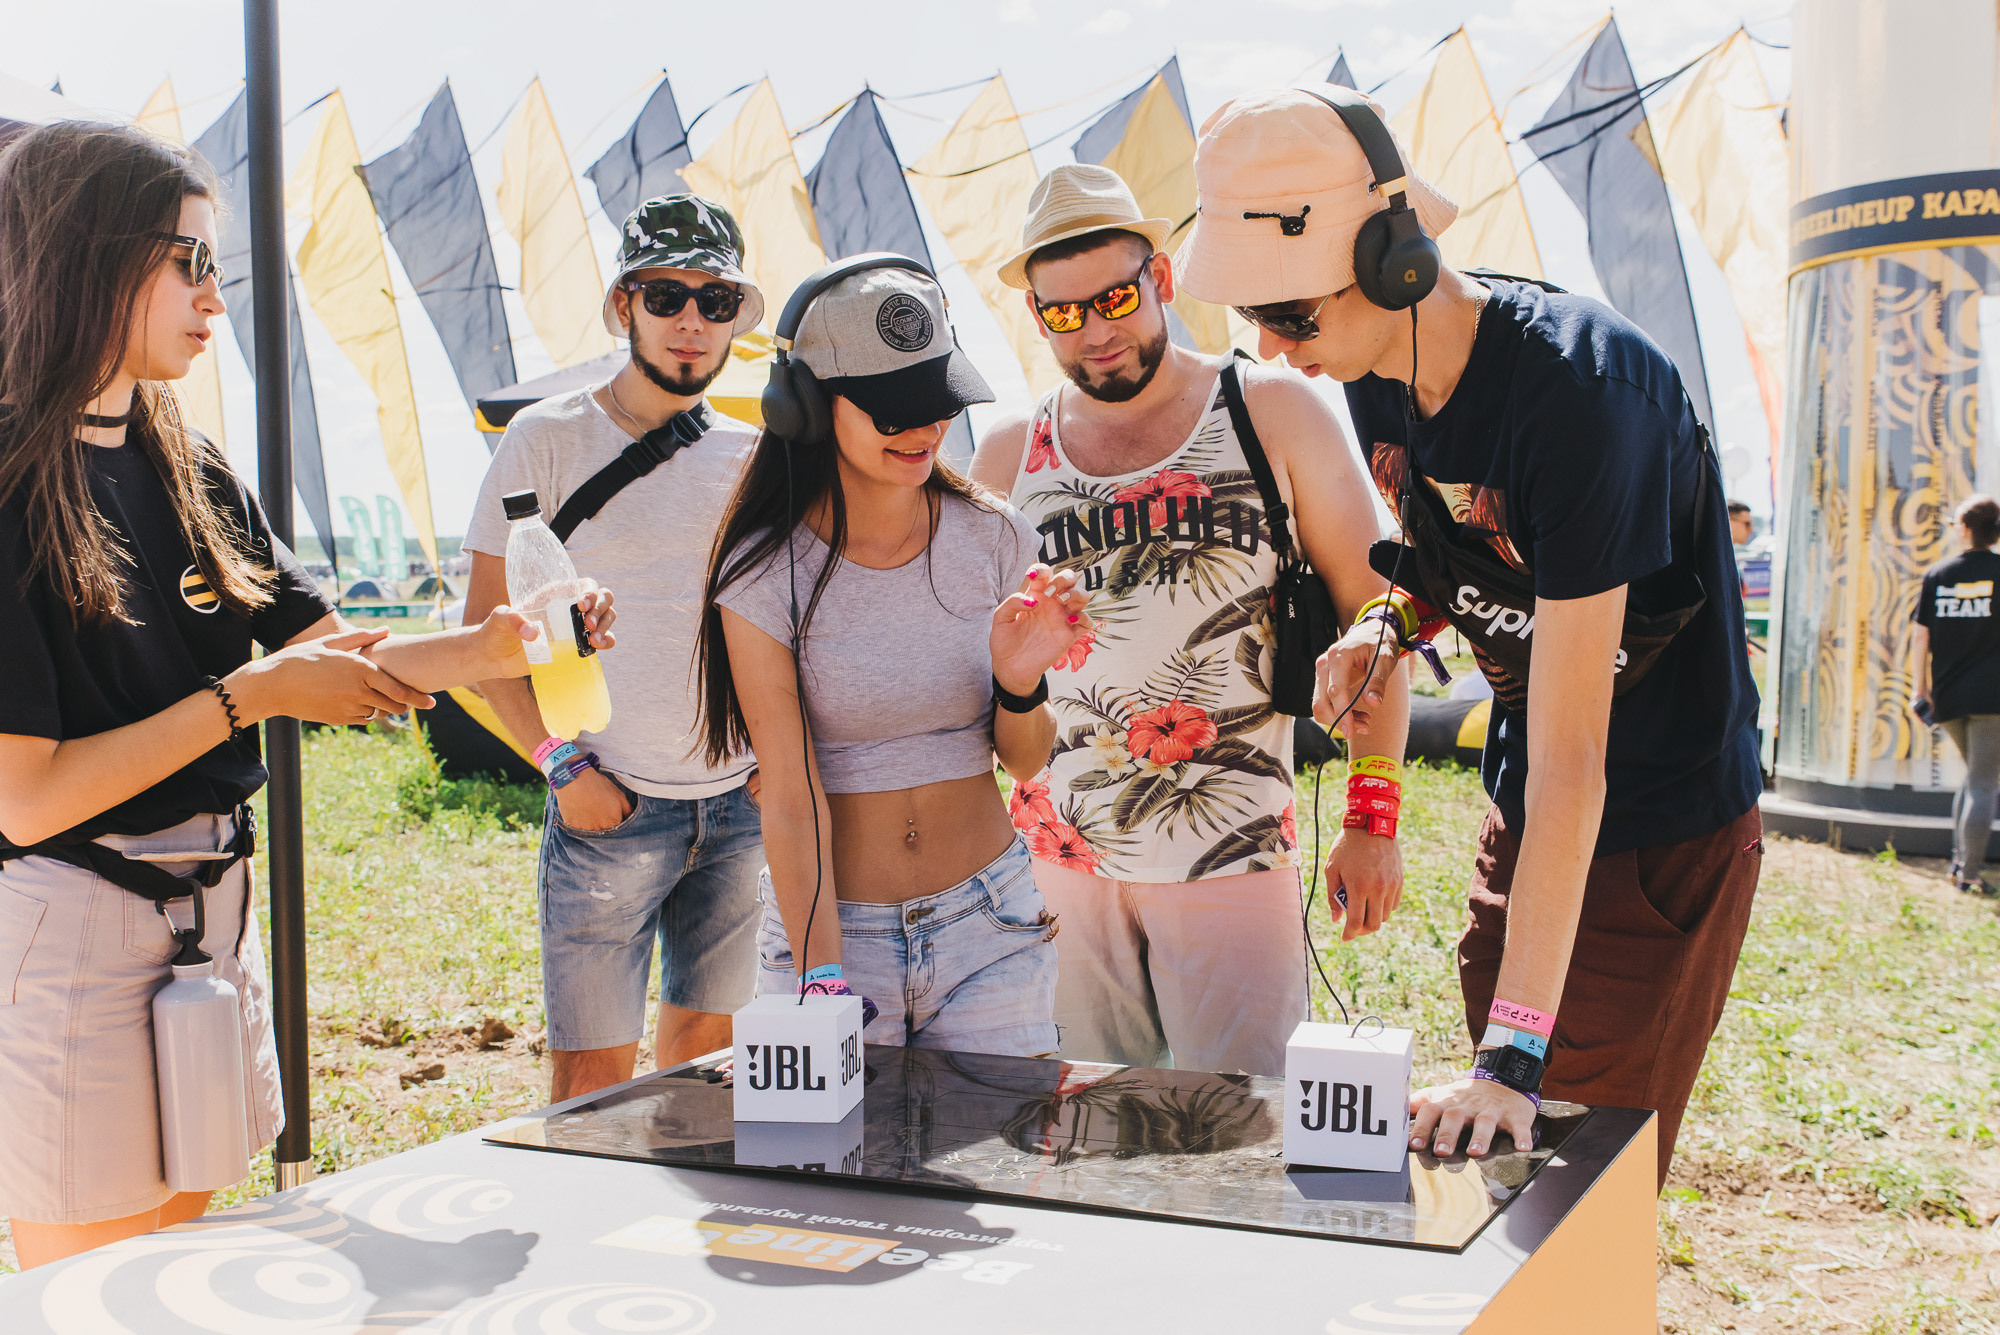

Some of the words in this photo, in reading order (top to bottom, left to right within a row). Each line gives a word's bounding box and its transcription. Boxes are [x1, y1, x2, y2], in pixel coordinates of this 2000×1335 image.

[1922, 187, 2000, 219] КАРА
[1036, 495, 1259, 567] ONOLULU
[1084, 555, 1191, 592] U.S.A.
[1935, 598, 1992, 618] TEAM
[1365, 760, 1396, 773] AFP
[1359, 777, 1389, 789] AFP
[746, 1044, 826, 1091] JBL
[841, 1030, 861, 1087] JBL
[1299, 1080, 1387, 1136] JBL
[699, 1201, 805, 1220] музыки
[803, 1213, 889, 1231] твоей
